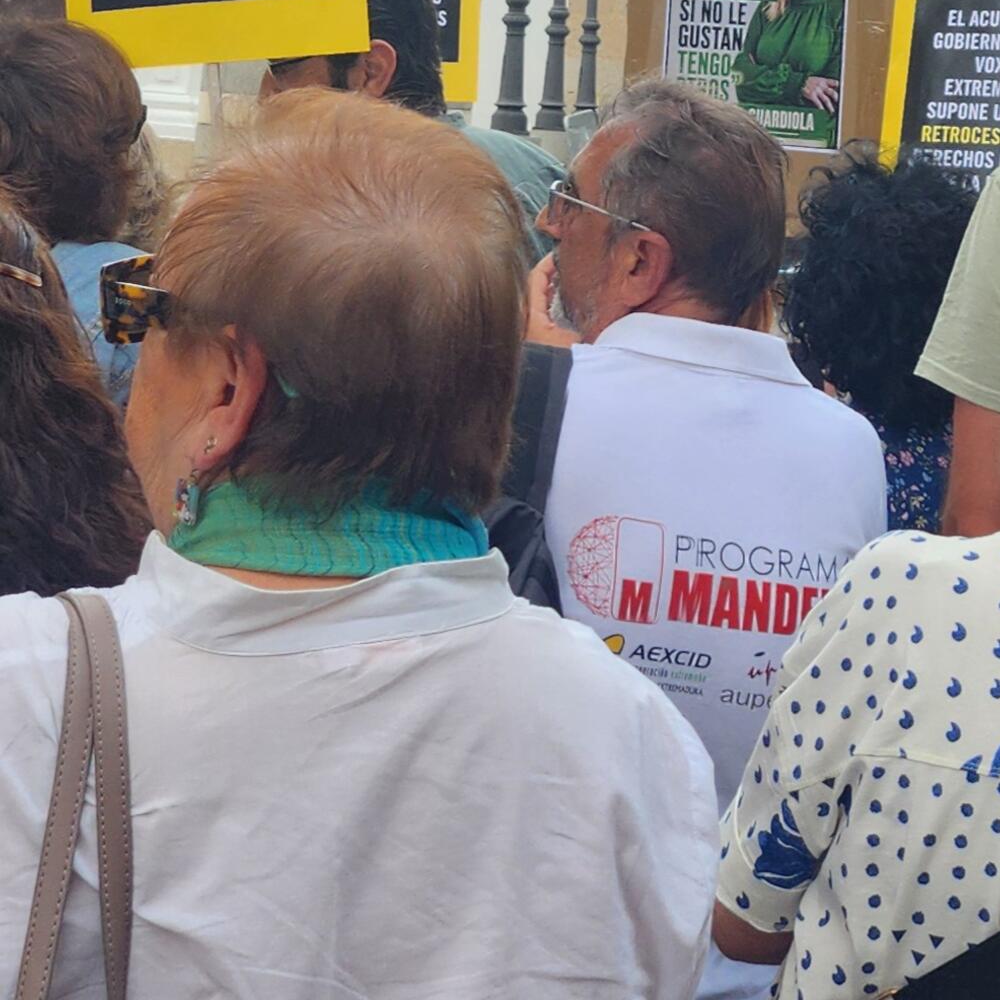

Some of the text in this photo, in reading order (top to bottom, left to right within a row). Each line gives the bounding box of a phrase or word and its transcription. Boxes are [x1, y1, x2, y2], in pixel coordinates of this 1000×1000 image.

[679, 0, 747, 26] SI NO LE
[947, 9, 966, 27] EL
[678, 24, 743, 51] GUSTAN
[678, 50, 731, 76] TENGO
[926, 101, 989, 121] SUPONE
[674, 535, 850, 582] PROGRAM
[667, 569, 829, 636] MANDE
[628, 644, 712, 669] AEXCID
